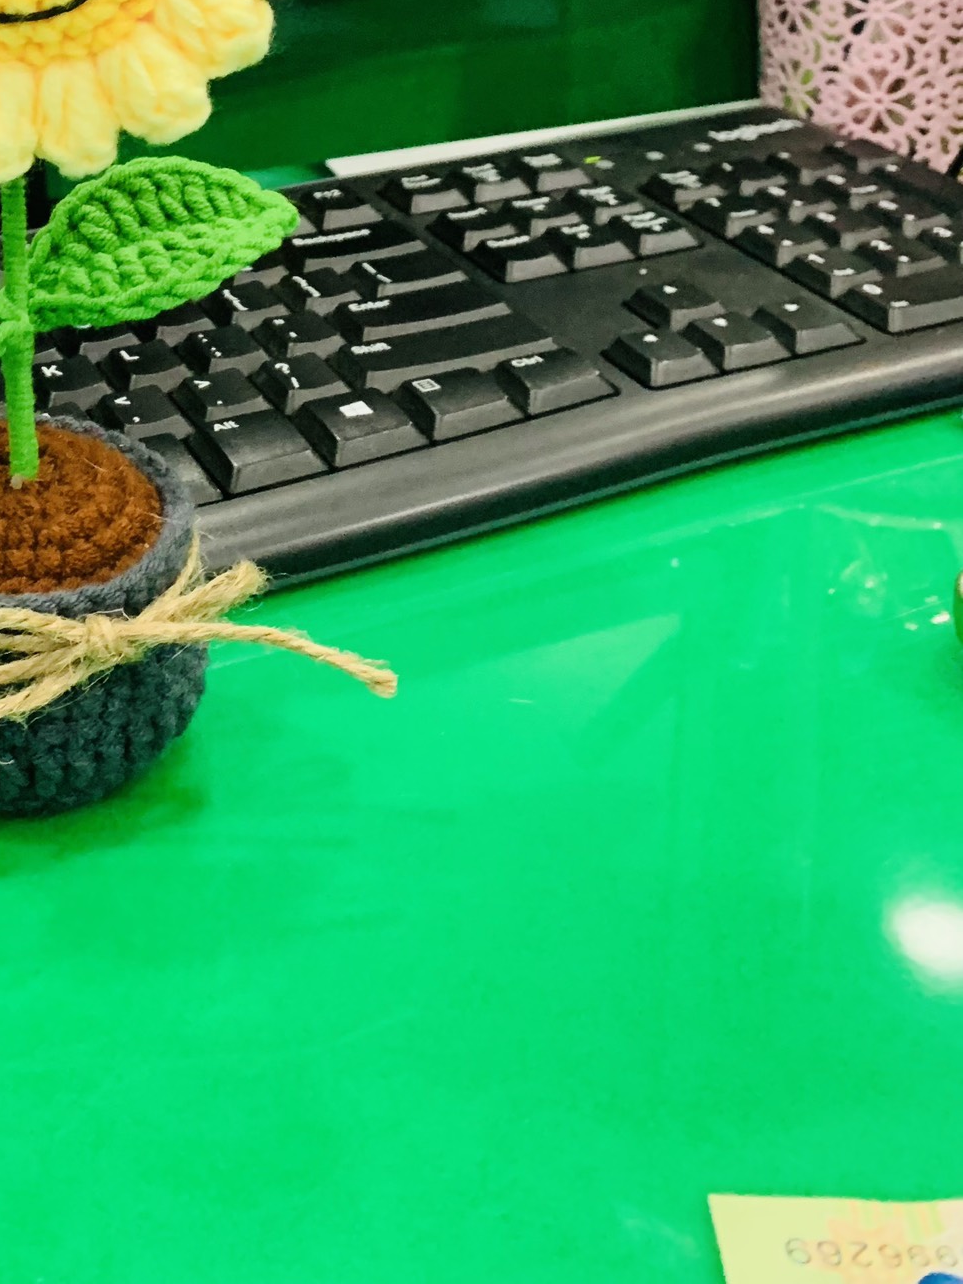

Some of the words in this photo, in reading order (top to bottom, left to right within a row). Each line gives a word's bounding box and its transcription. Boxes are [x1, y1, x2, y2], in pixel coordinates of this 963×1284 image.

[120, 350, 139, 360] L
[41, 365, 63, 377] K
[213, 420, 239, 431] Alt
